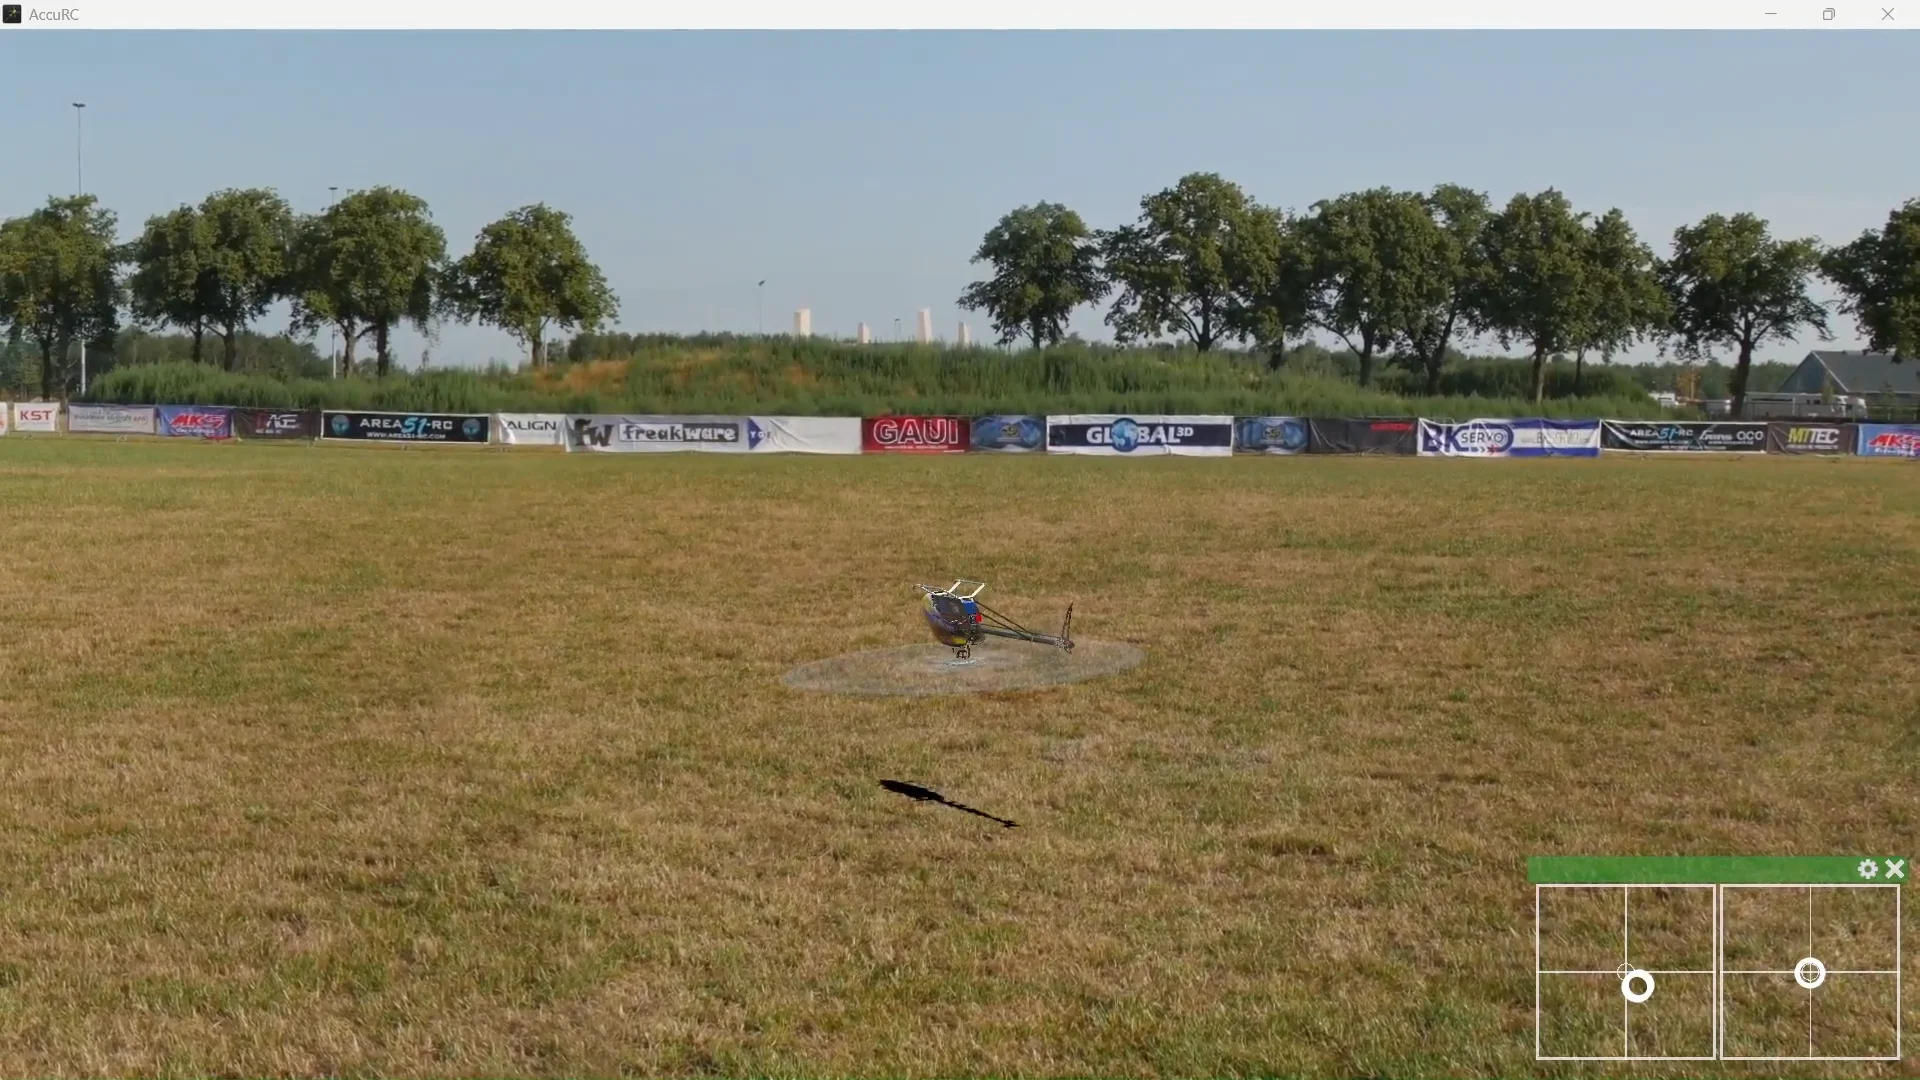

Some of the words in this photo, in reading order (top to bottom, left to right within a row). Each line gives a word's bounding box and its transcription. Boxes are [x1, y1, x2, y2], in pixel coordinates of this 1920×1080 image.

[29, 8, 80, 21] AccuRC
[20, 410, 52, 420] KST
[169, 414, 226, 429] MKS
[360, 417, 453, 433] AREA51-RC
[506, 420, 557, 431] ALIGN
[873, 419, 959, 444] GAUI
[624, 424, 736, 441] freakware
[1460, 432, 1504, 444] SERVO
[1629, 427, 1694, 440] AREA51-RC
